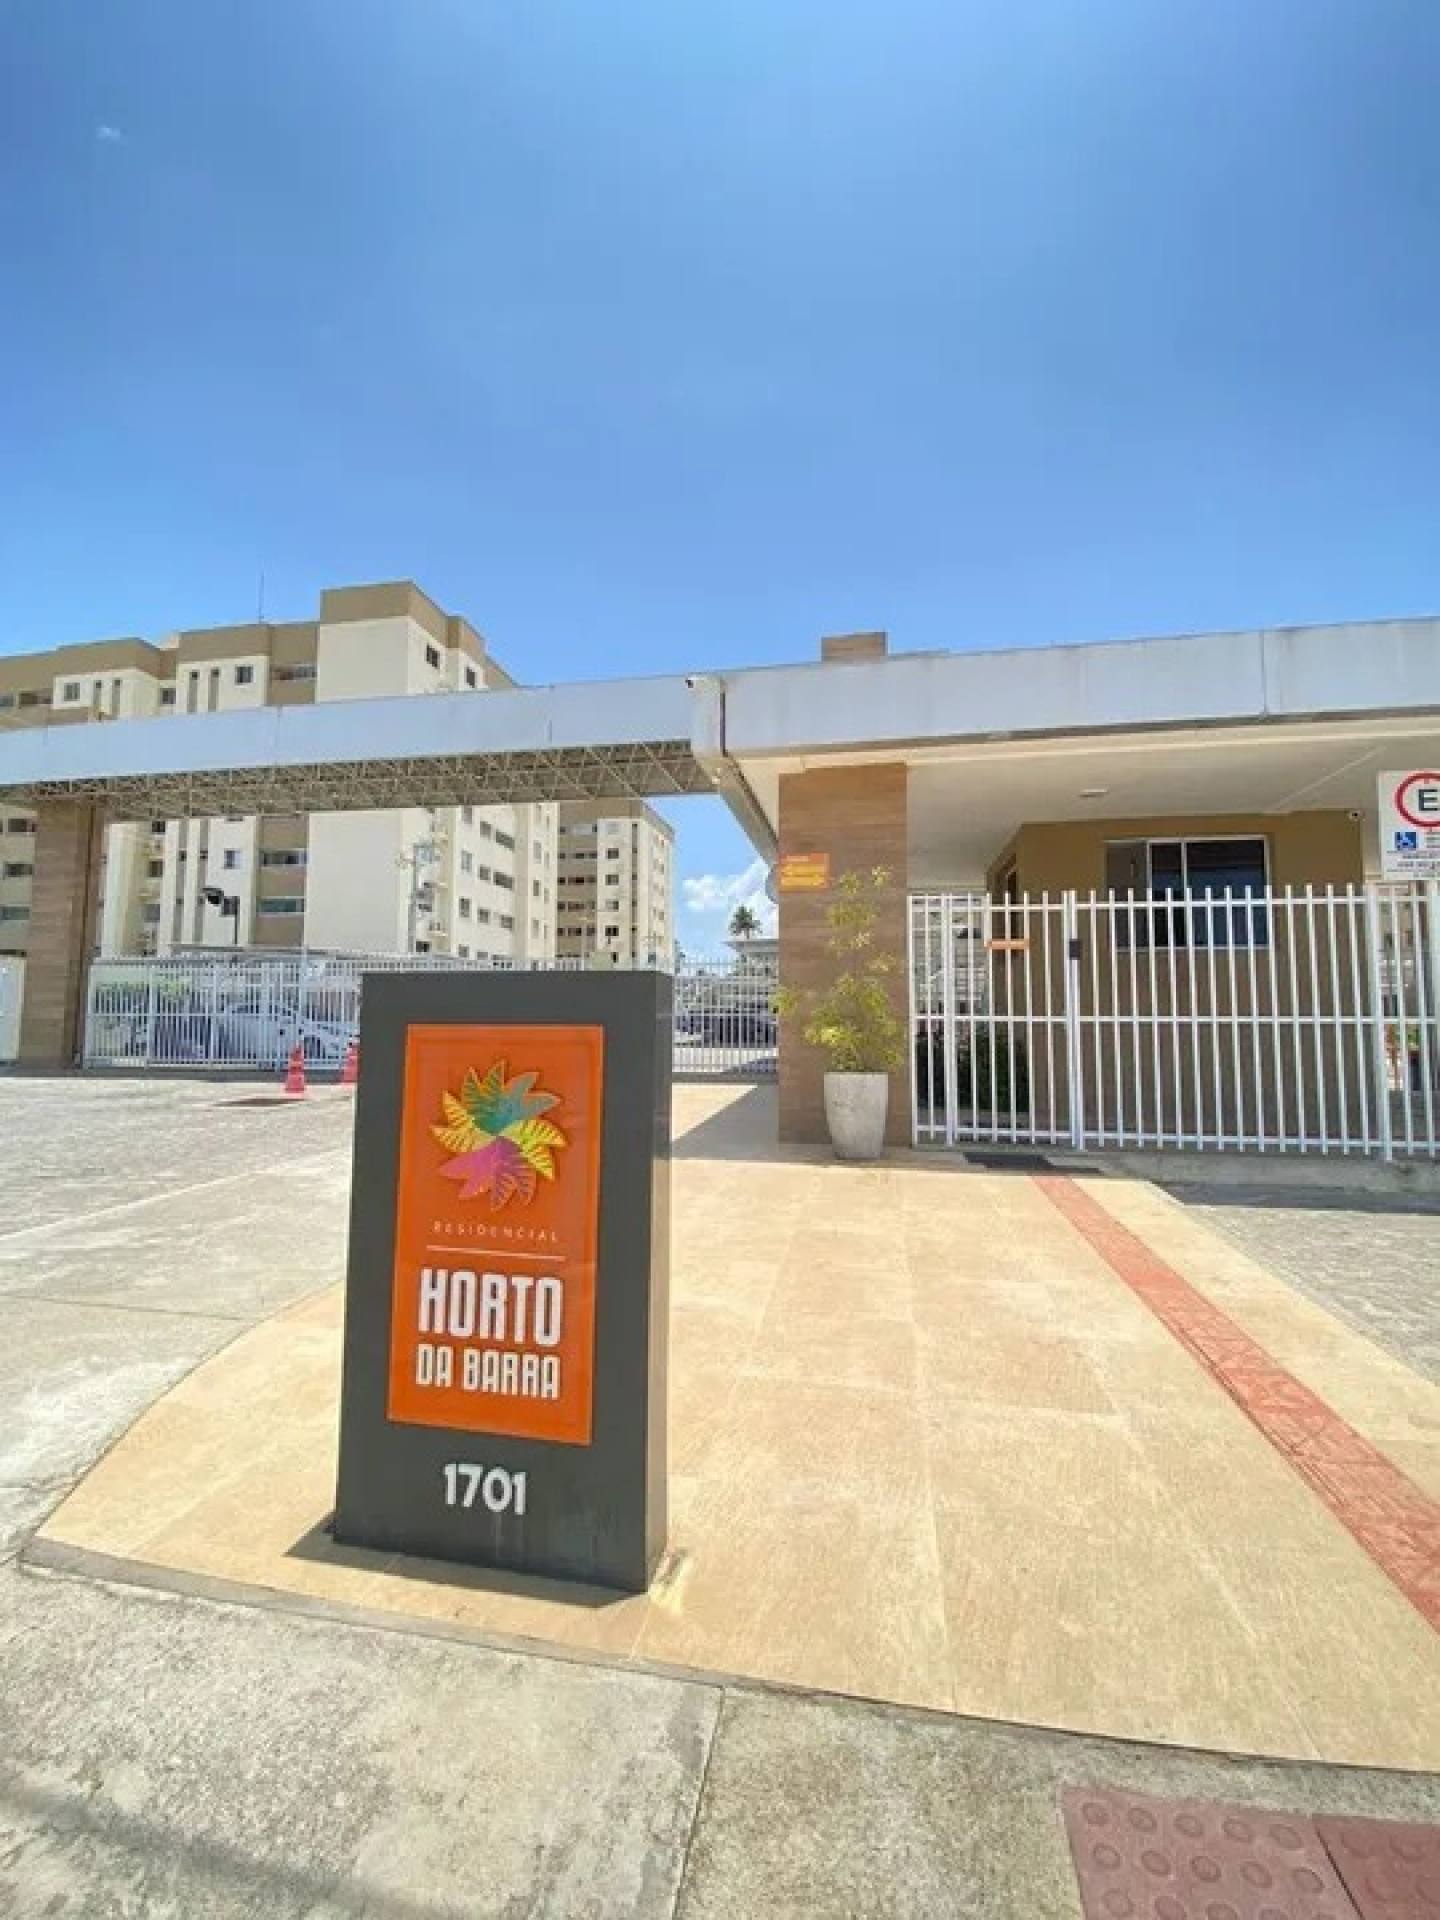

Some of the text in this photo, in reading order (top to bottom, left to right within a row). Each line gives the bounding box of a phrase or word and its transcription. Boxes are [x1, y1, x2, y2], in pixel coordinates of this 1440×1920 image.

[1418, 788, 1438, 811] E
[433, 1221, 557, 1241] RESIDENCIAL
[418, 1268, 562, 1346] HORTO
[416, 1343, 561, 1399] DA BARRA
[444, 1463, 526, 1516] 1701
